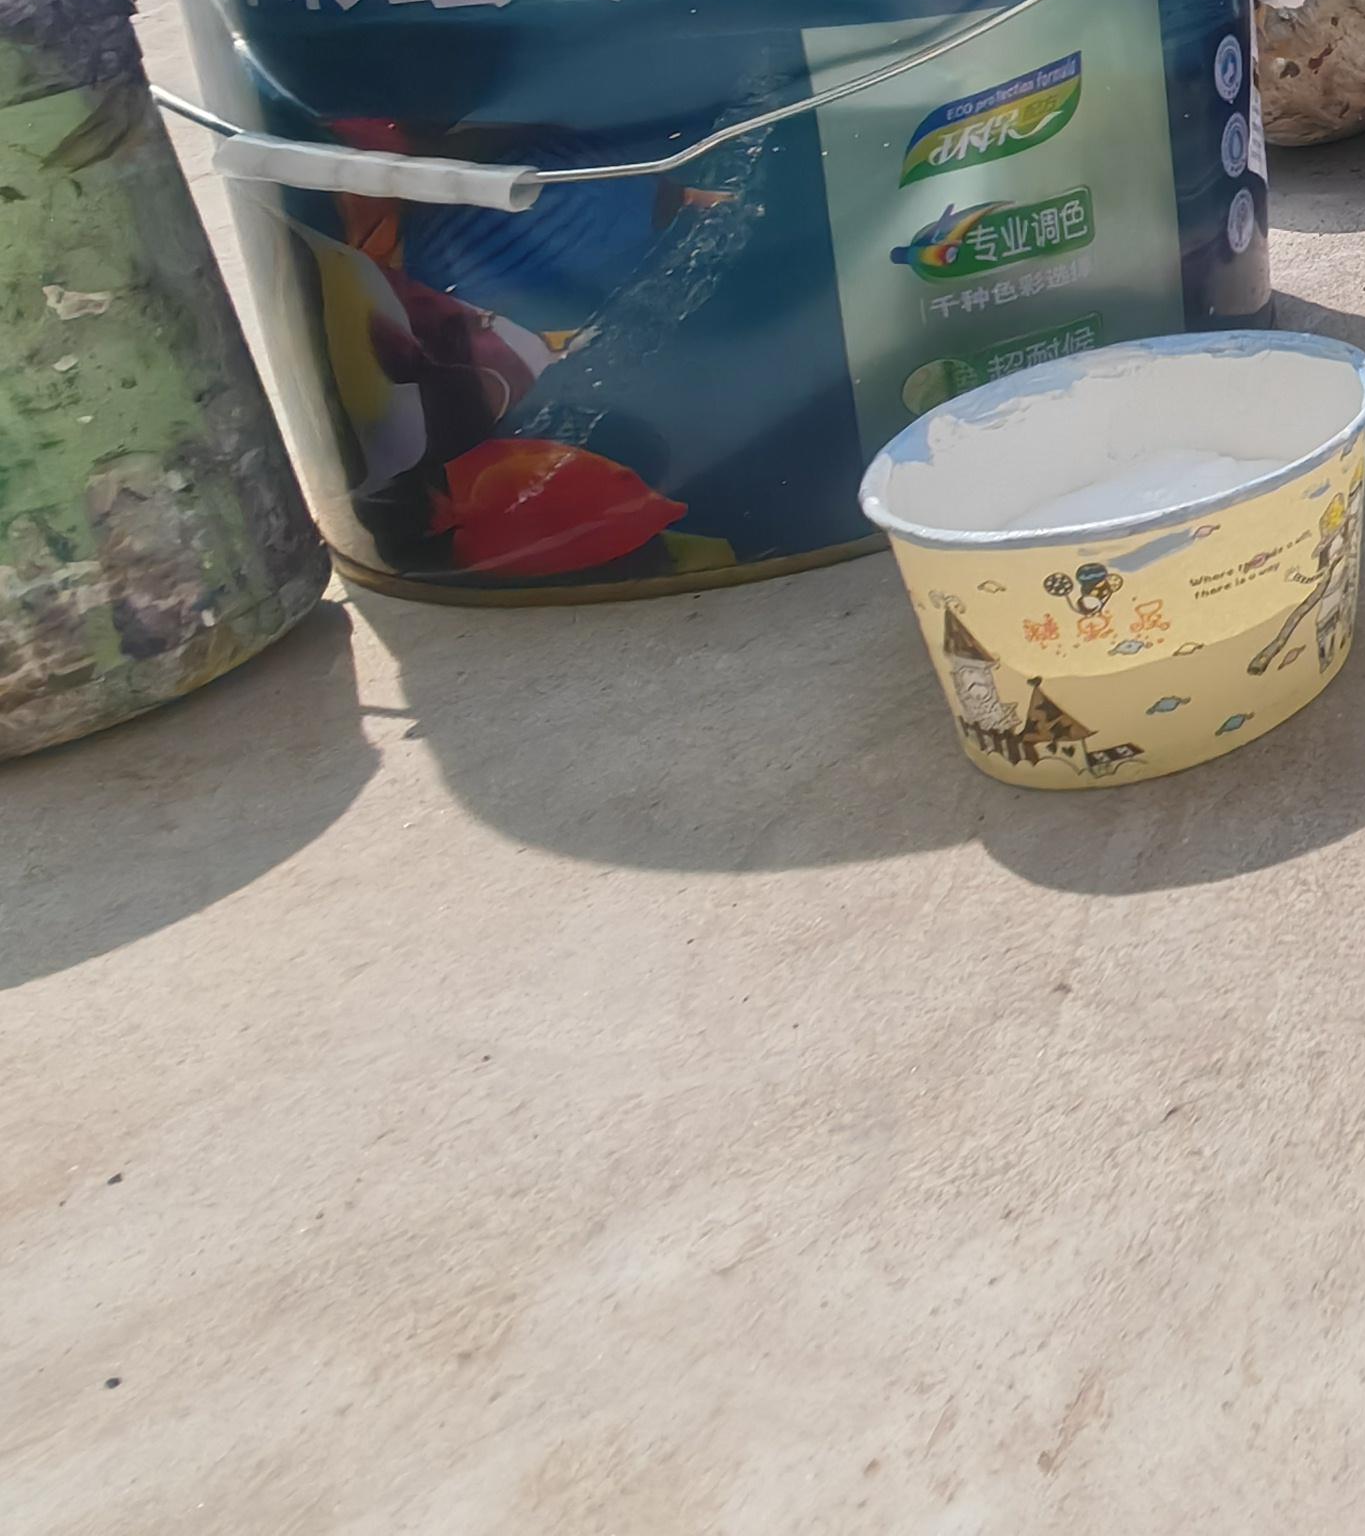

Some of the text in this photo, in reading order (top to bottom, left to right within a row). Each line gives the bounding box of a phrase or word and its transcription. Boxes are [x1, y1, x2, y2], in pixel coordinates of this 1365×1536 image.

[946, 103, 975, 121] ECO
[966, 199, 1088, 261] 专业调色
